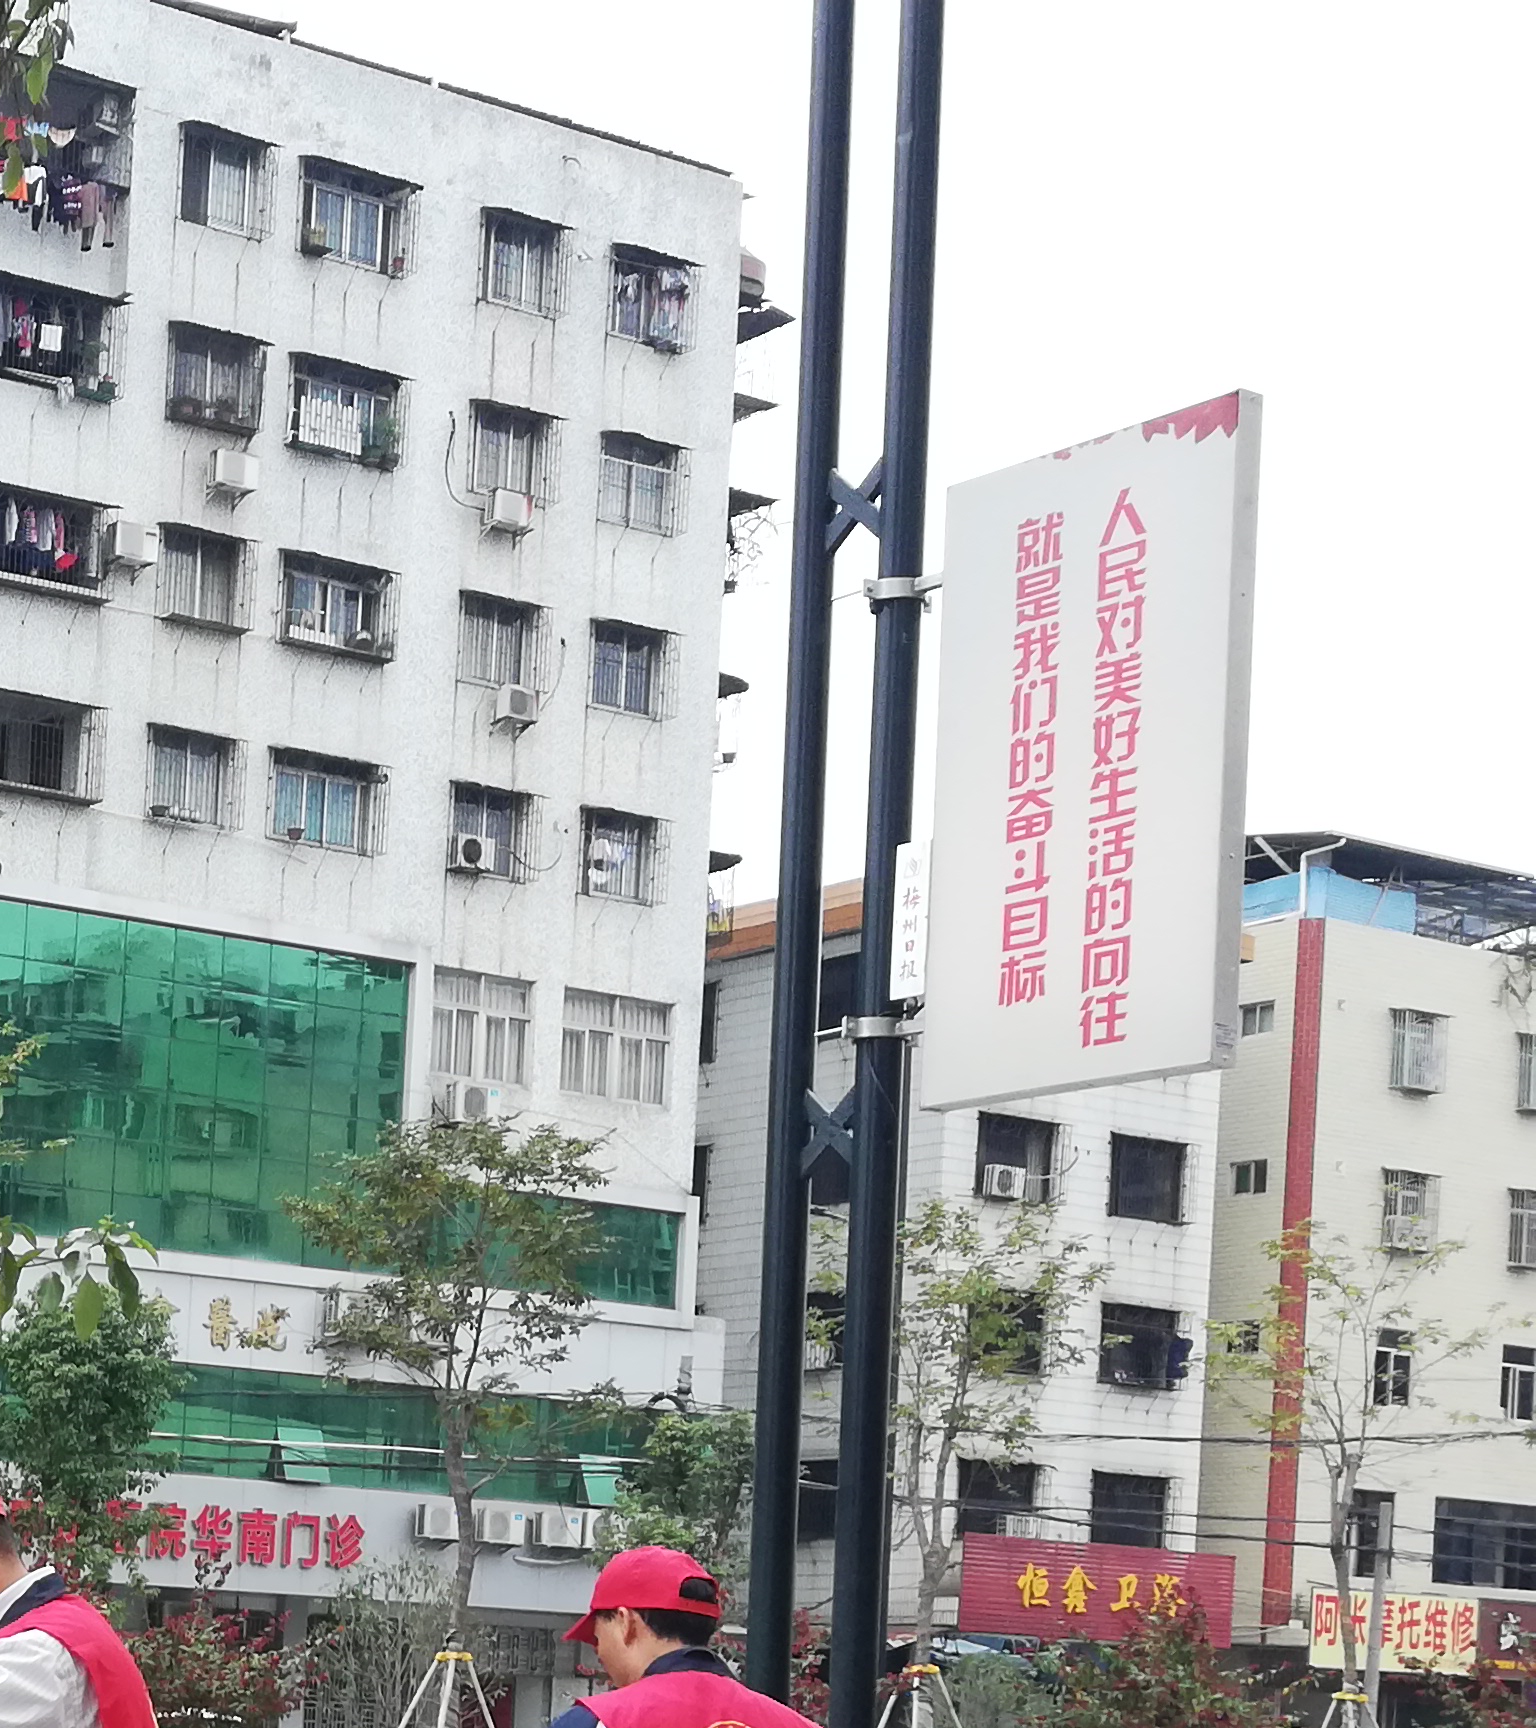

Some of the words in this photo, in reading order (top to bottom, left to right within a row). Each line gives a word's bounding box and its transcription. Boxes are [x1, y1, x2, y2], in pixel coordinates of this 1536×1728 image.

[899, 886, 922, 981] 梅州日报
[999, 511, 1064, 1008] 就是我们的奋斗目标
[1079, 487, 1147, 1049] 人民对美好生活的向往
